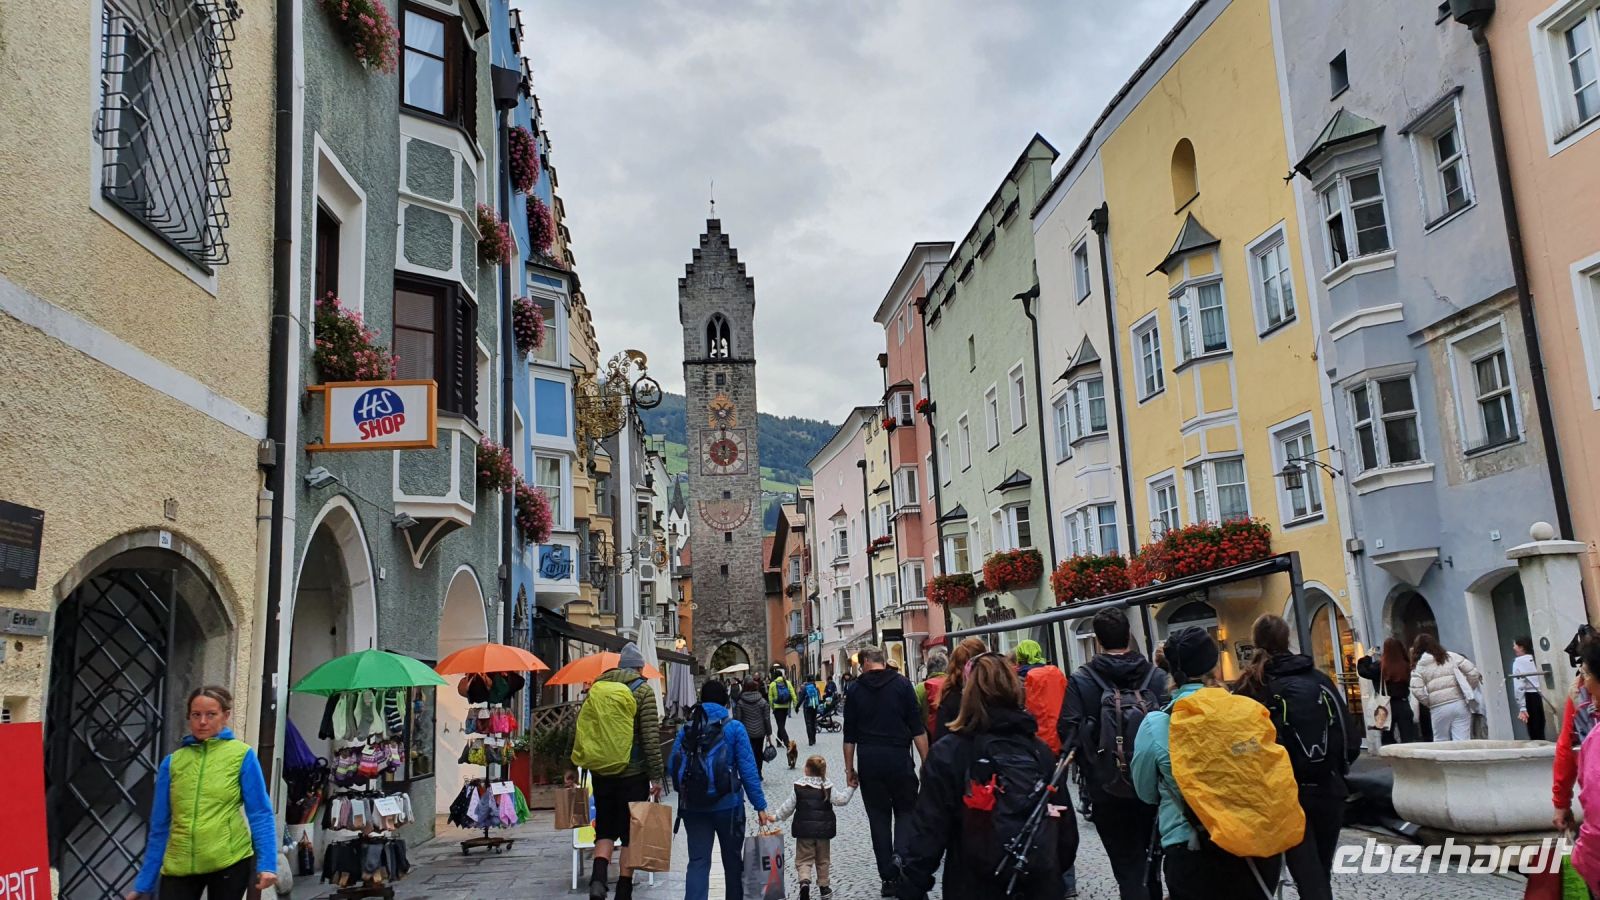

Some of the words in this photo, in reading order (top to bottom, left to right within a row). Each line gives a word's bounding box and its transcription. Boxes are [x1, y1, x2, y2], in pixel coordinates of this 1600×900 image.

[358, 391, 392, 418] HS
[359, 413, 405, 440] SHOP
[13, 612, 38, 626] Erker
